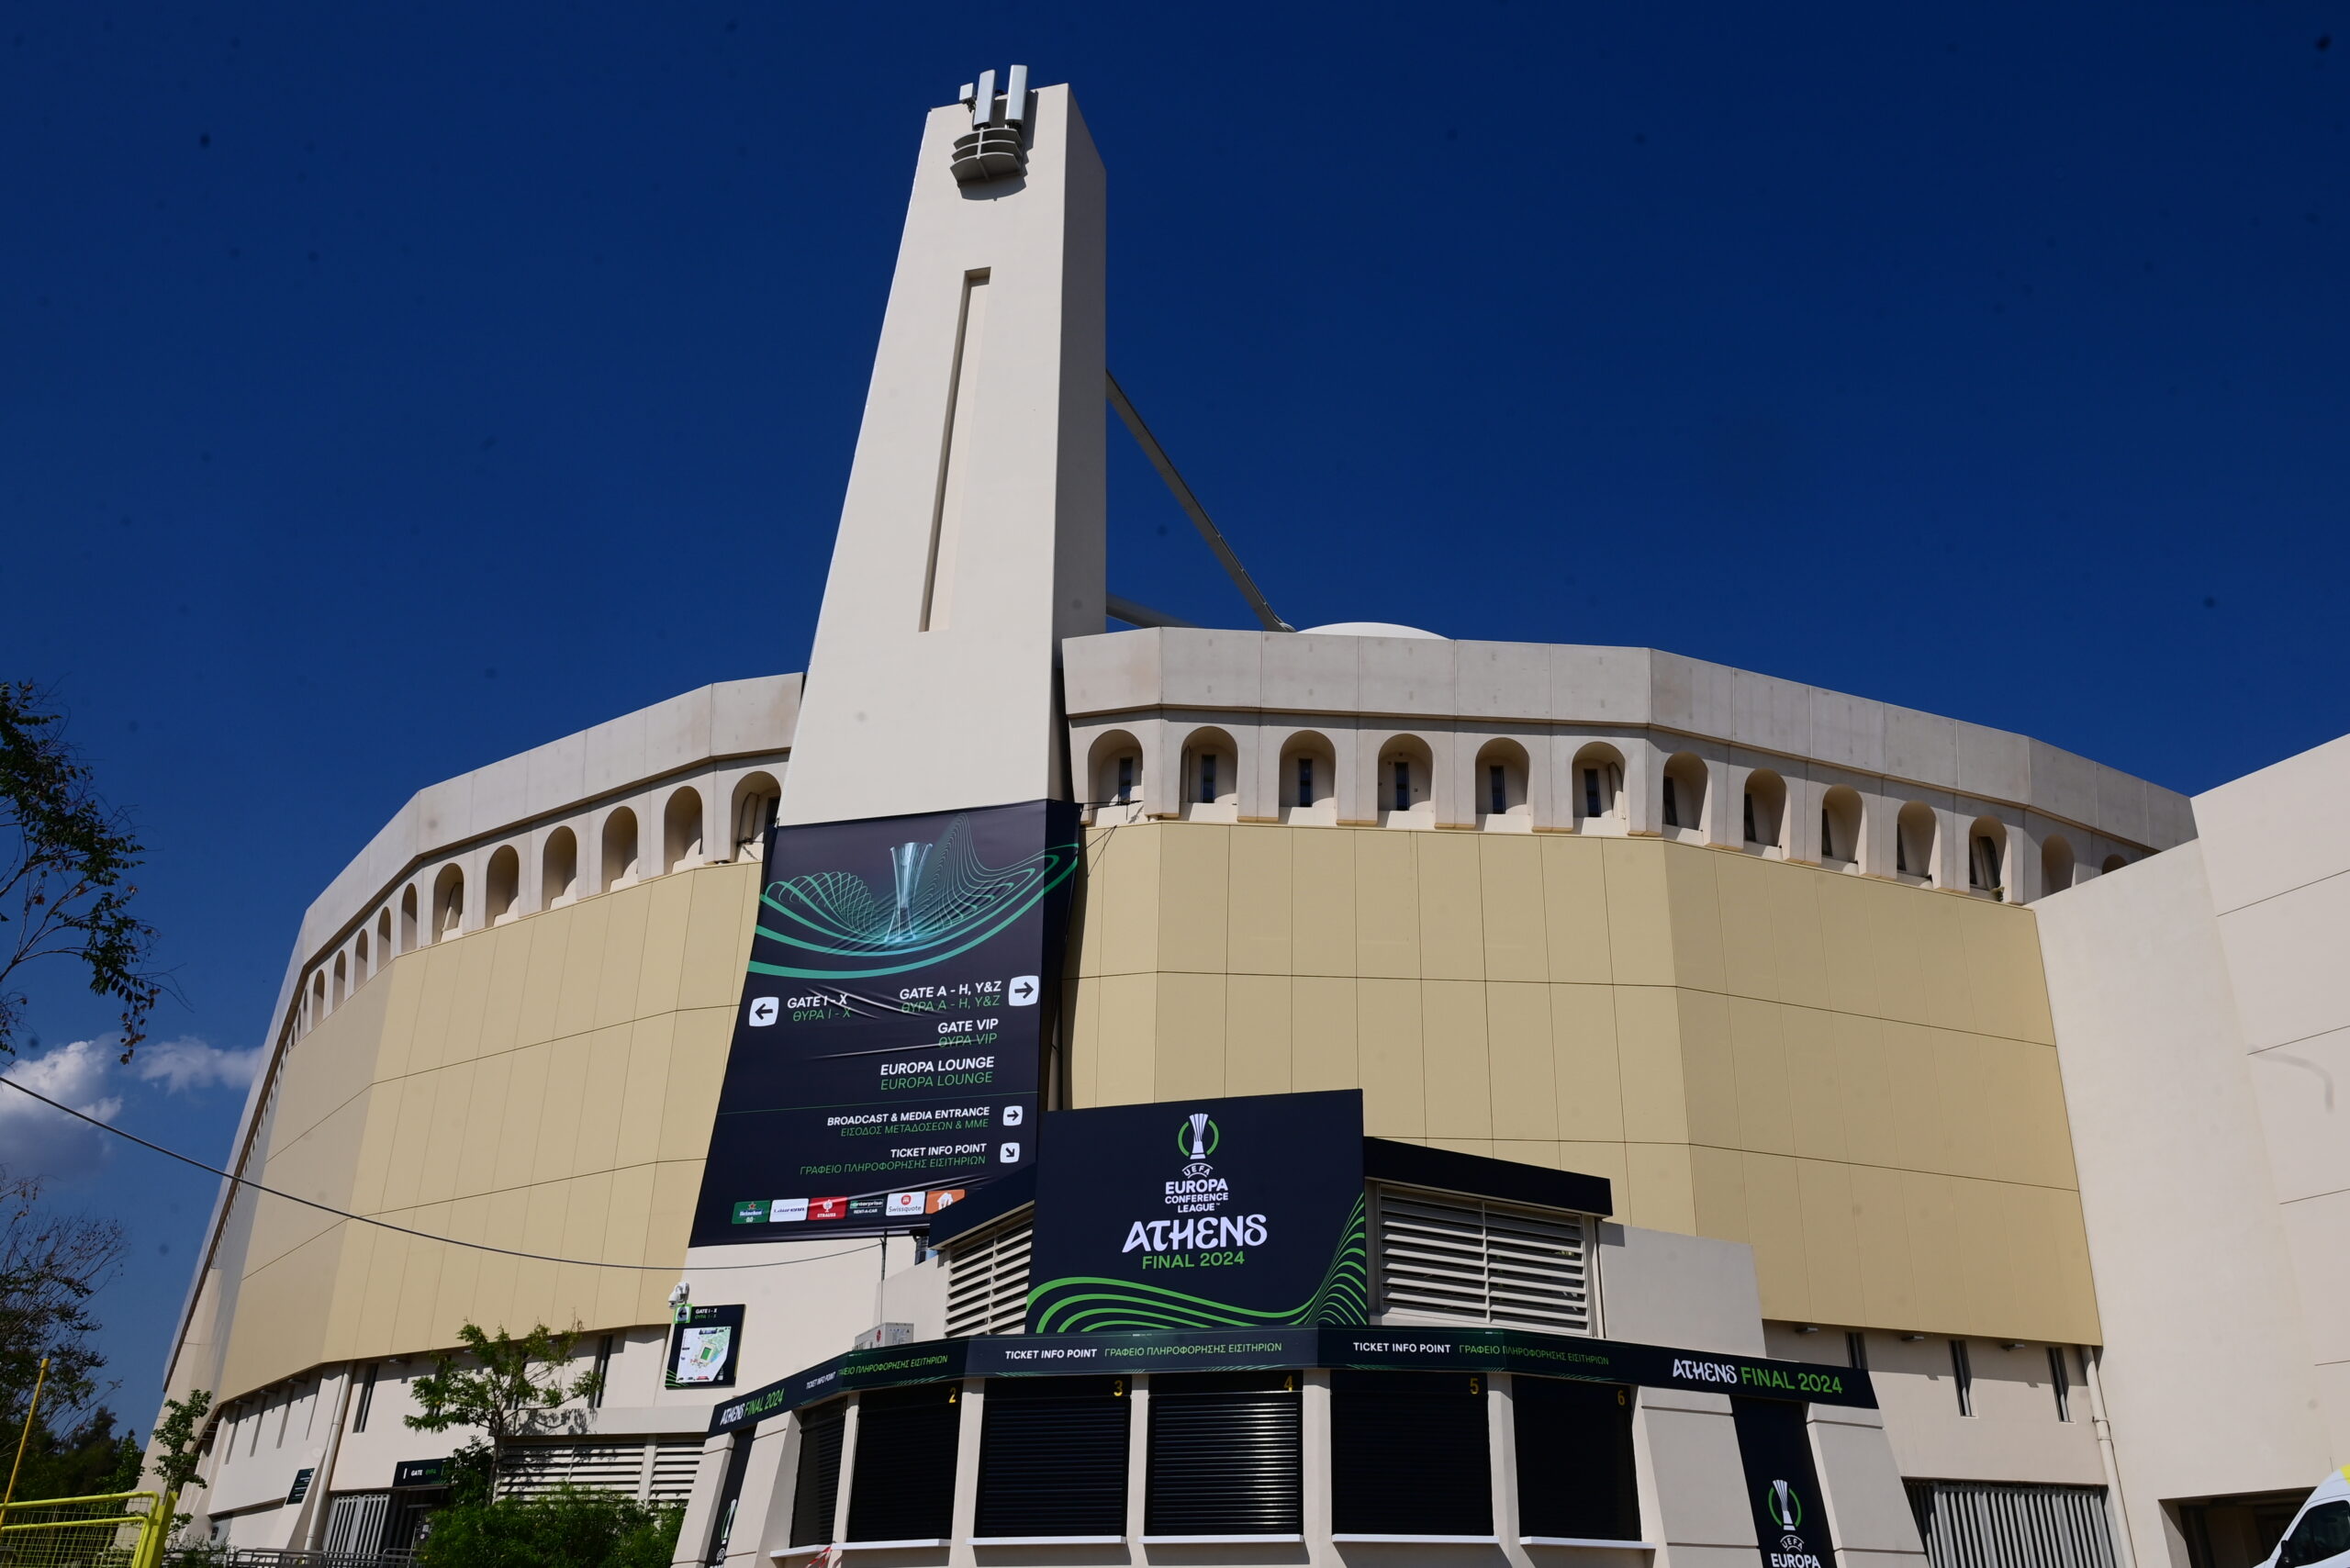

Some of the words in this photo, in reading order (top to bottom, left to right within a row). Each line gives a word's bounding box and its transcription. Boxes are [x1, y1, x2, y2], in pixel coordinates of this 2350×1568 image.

[900, 987, 934, 1000] GATE
[937, 985, 947, 996] A
[958, 983, 971, 995] H,
[975, 980, 1002, 993] Y&Z
[787, 996, 822, 1009] GATE
[839, 993, 848, 1005] X
[975, 995, 1001, 1007] Y&Z
[792, 1010, 824, 1022] ΘΥΡΑ
[938, 1021, 973, 1034] GATE
[976, 1018, 999, 1031] VIP
[976, 1033, 998, 1046] VIP
[880, 1060, 934, 1076] EUROPA
[937, 1056, 995, 1071] LOUNGE
[880, 1076, 934, 1091] EUROPA
[937, 1071, 993, 1087] LOUNGE
[827, 1113, 889, 1126] BROADCAST
[890, 1113, 898, 1123] &
[900, 1110, 933, 1122] MEDIA
[934, 1106, 990, 1119] ENTRANCE
[841, 1126, 882, 1137] ΕΙΣΟΔΟΣ
[884, 1121, 953, 1135] ΜΕΤΑΔΟΣΕΩΝ
[956, 1121, 963, 1129] &
[890, 1147, 926, 1159] TICKET
[928, 1145, 953, 1156] INFO
[955, 1143, 987, 1154] POINT
[800, 1163, 842, 1176] ΓΡΑΦΕΙΟ
[844, 1159, 928, 1173] ΠΛΗΡΟΦΟΡΗΣΗΣ
[930, 1155, 986, 1168] ΕΙΣΙΤΗΡΙΩΝ
[1184, 1165, 1211, 1176] UEFA
[1165, 1178, 1228, 1194] EUROPA
[1165, 1193, 1229, 1204] CONFERENCE
[1122, 1214, 1268, 1253] ATHENS
[1142, 1254, 1194, 1270] FINAL
[1200, 1250, 1245, 1267] 2024
[1005, 1350, 1038, 1360] TICKET
[1041, 1350, 1065, 1359] INFO
[1067, 1349, 1097, 1359] POINT
[1104, 1347, 1145, 1357] ΓΡΑΦΕΙΟ
[1147, 1345, 1225, 1356] ΠΛΗΡΟΦΟΡΗΣΗΣ
[1228, 1343, 1282, 1353] ΕΙΣΙΤΗΡΙΩΝ
[1353, 1342, 1389, 1352] TICKET
[1393, 1343, 1416, 1352] INFO
[1420, 1344, 1450, 1353] POINT
[1459, 1345, 1500, 1355] ΓΡΑΦΕΙΟ
[1503, 1346, 1566, 1361] ΠΛΗΡΟΦΟΡΗΣΗΣ
[1568, 1352, 1608, 1365] ΕΙΣΙΤΗΡΙΩΝ
[1283, 1376, 1292, 1392] 4
[1673, 1359, 1737, 1383] ATHENS
[1740, 1366, 1795, 1390] FINAL
[1797, 1372, 1842, 1394] 2024
[1113, 1380, 1123, 1396] 3
[1471, 1378, 1479, 1394] 5
[949, 1387, 957, 1404] 2
[1617, 1390, 1625, 1406] 6
[720, 1403, 744, 1426] ATHENS
[744, 1396, 764, 1417] FINAL
[765, 1388, 785, 1409] 2024
[1782, 1538, 1803, 1550] UEFA
[1771, 1553, 1822, 1568] EUROPA
